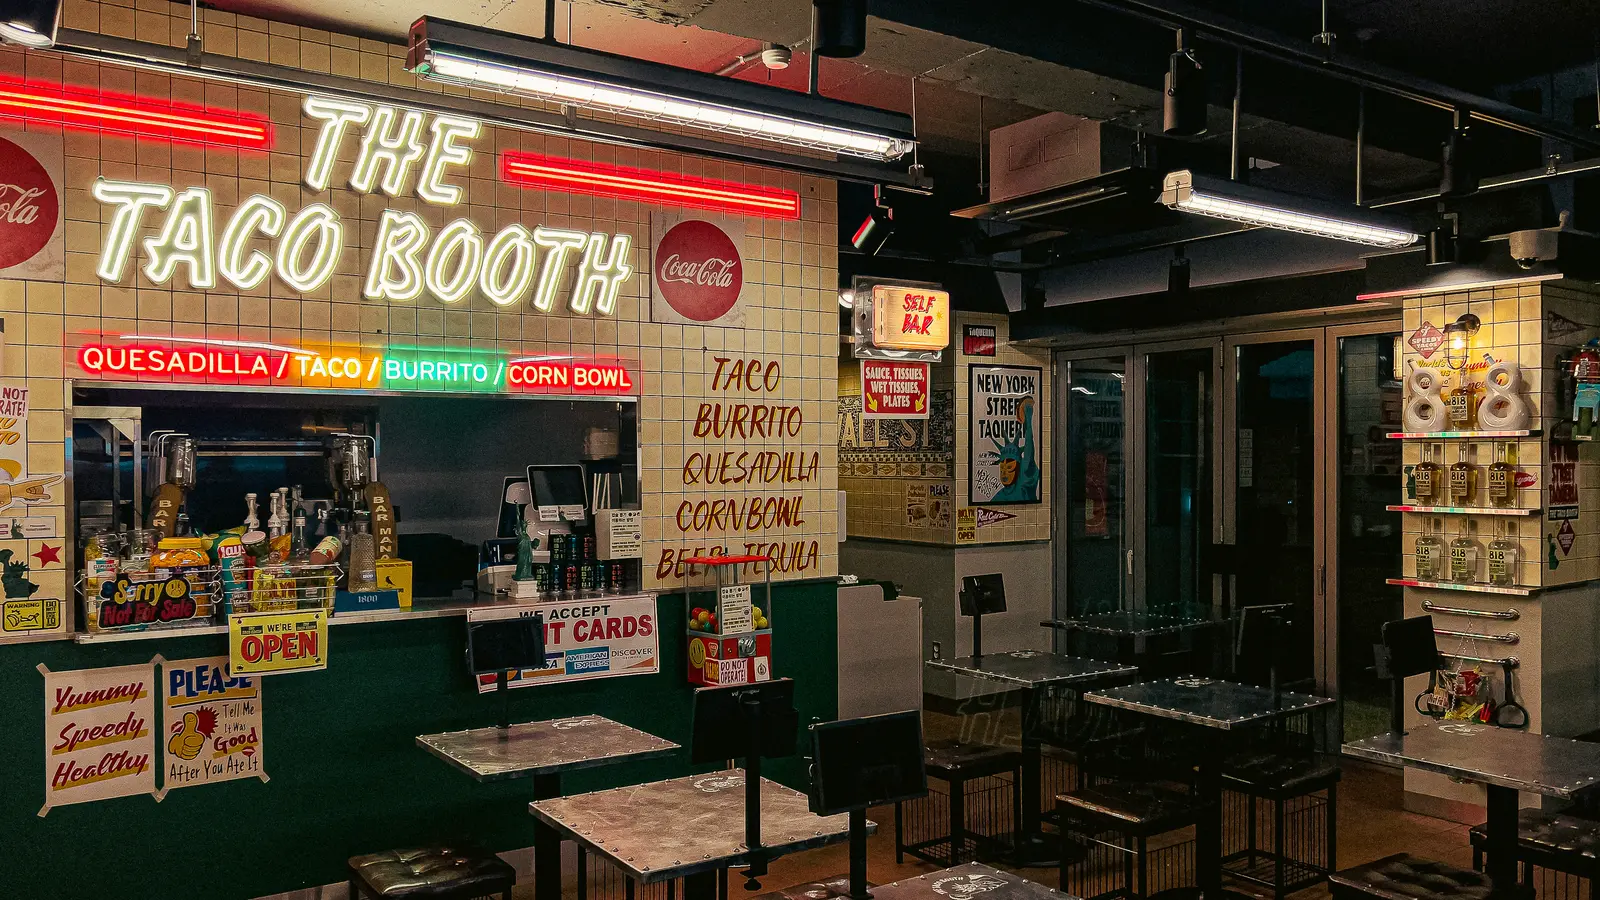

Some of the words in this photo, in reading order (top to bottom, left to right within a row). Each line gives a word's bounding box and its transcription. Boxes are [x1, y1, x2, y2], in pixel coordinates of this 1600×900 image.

[303, 96, 482, 205] THE
[93, 176, 344, 294] TACO
[362, 208, 633, 316] BOOTH
[903, 293, 936, 314] SELF
[901, 313, 934, 336] BAR
[969, 327, 995, 337] TAQUERIA
[84, 348, 268, 375] QUESADILLA
[295, 355, 361, 379] TACO
[385, 360, 488, 383] BURRITO
[509, 365, 567, 386] CORN
[574, 368, 631, 388] BOWL
[712, 356, 780, 392] TACO
[865, 366, 892, 381] SAUCE,
[893, 368, 924, 381] TISSUES,
[871, 381, 889, 394] WET
[890, 382, 920, 395] TISSUES,
[977, 373, 1003, 393] NEW
[1006, 375, 1034, 394] YORK
[3, 388, 28, 400] NOT
[883, 395, 910, 408] PLATES
[1451, 396, 1466, 406] 818
[987, 397, 1021, 416] STREE
[693, 403, 802, 439] BURRITO
[838, 412, 889, 447] ALL
[979, 419, 1027, 439] TAQUERI
[683, 451, 819, 485] QUESADILLA
[1416, 472, 1430, 480] 818
[1451, 472, 1465, 480] 818
[1490, 472, 1505, 481] 818
[153, 500, 172, 527] BAR
[373, 496, 389, 521] BAR
[676, 497, 748, 532] CORN
[746, 496, 805, 531] BOWL
[958, 531, 975, 540] OPEN
[743, 540, 819, 577] TEQUILA
[1416, 546, 1430, 555] 818
[1451, 548, 1466, 558] 818
[1490, 551, 1505, 560] 818
[114, 580, 165, 606] Sorry
[358, 595, 378, 603] 1800
[104, 605, 132, 625] Not
[135, 602, 157, 621] For
[161, 600, 193, 620] Sale
[549, 605, 611, 620] ACCEPT
[267, 623, 292, 632] WE'RE
[573, 614, 653, 642] CARDS
[241, 631, 318, 664] OPEN
[566, 652, 607, 662] AMERICAN
[612, 648, 652, 657] DISCOVER
[574, 660, 610, 670] EXPRESS
[721, 661, 730, 670] DO
[732, 660, 747, 669] NOT
[721, 669, 747, 683] OPERATE!
[55, 682, 144, 713] Yummy
[223, 702, 240, 719] Tell
[243, 701, 255, 716] Me
[54, 711, 145, 752] Speedy
[224, 723, 232, 734] It
[233, 722, 247, 732] Was
[213, 727, 258, 754] Good
[52, 750, 149, 788] Healthy
[170, 763, 200, 782] After
[204, 759, 223, 779] You
[227, 755, 245, 774] Ate
[248, 755, 258, 771] It
